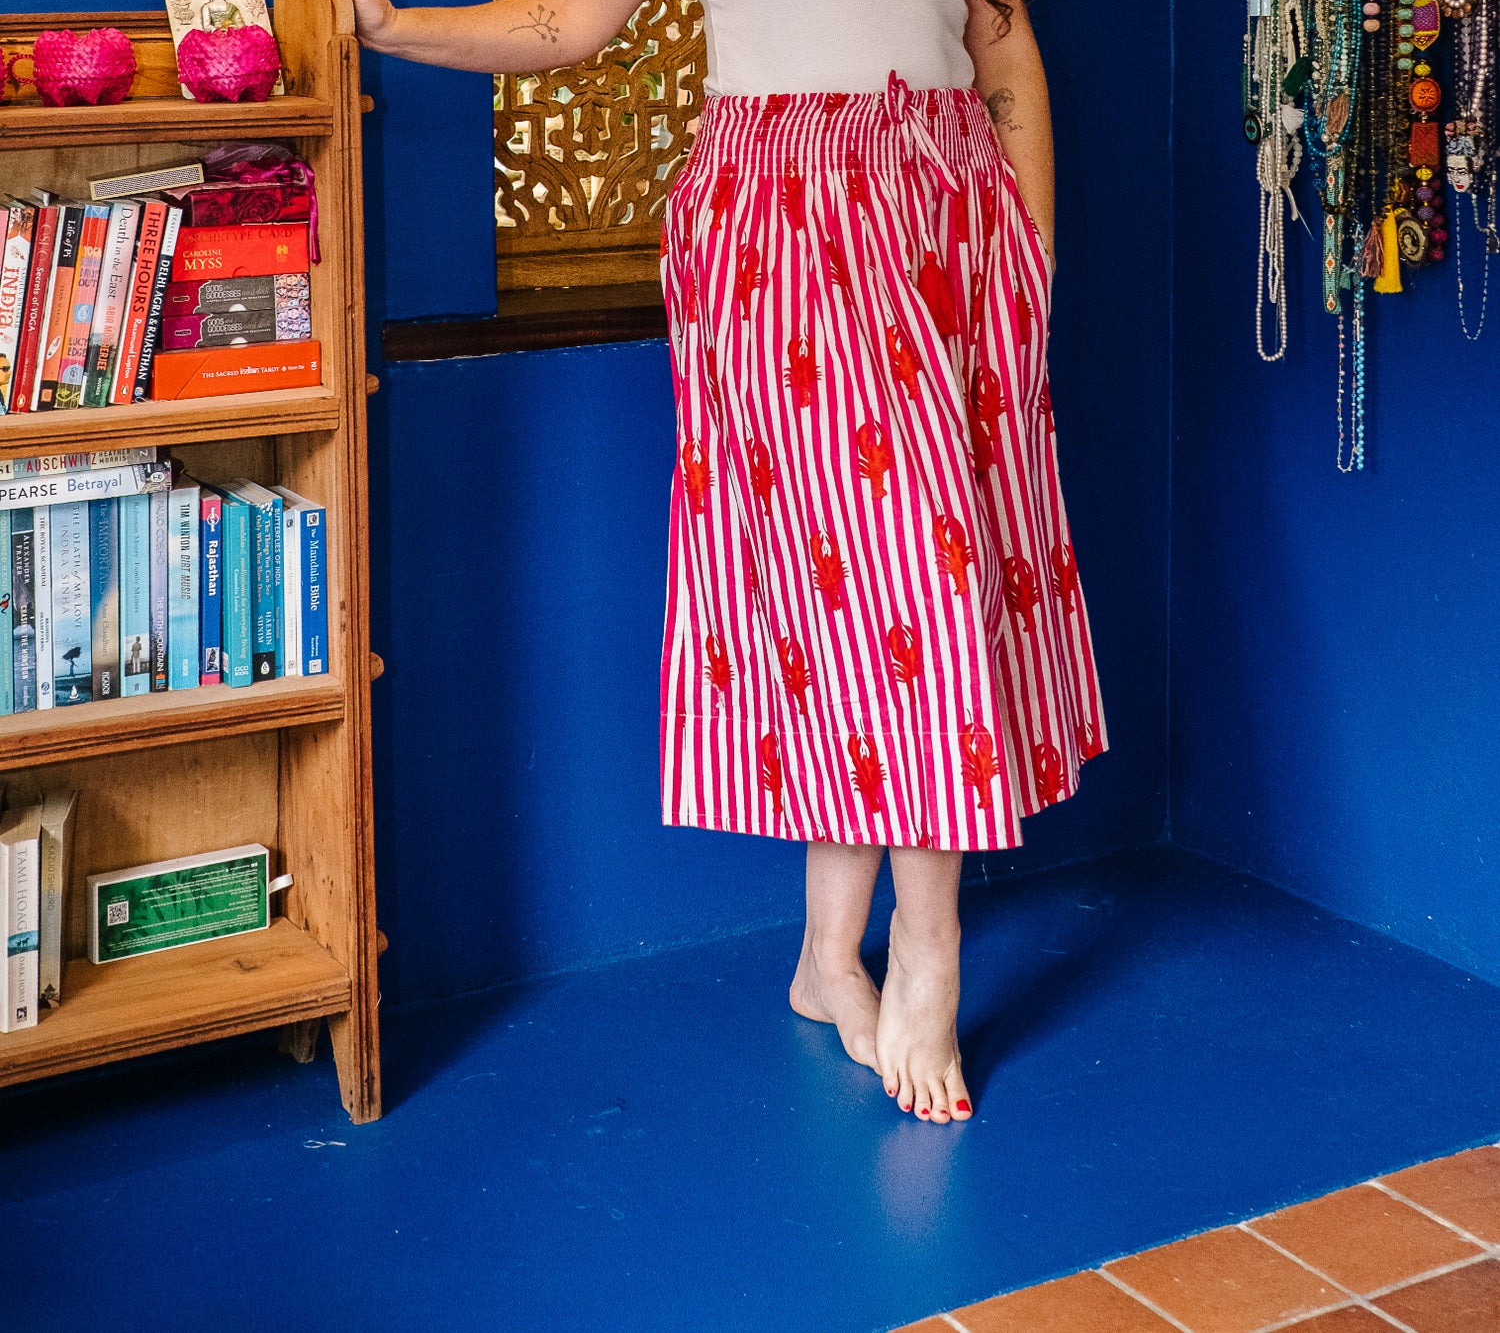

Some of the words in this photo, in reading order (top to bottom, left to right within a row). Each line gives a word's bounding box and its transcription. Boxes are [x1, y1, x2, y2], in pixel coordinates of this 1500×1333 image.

[66, 220, 76, 236] Life
[116, 207, 134, 244] Death
[144, 211, 161, 254] THREE
[63, 249, 72, 258] Pi
[64, 238, 74, 248] of
[115, 247, 122, 255] in
[183, 248, 222, 258] CAROLINE
[113, 258, 122, 271] the
[184, 257, 222, 270] MYSS
[34, 266, 44, 294] Secrets
[78, 278, 98, 287] OUT
[107, 275, 121, 299] East
[134, 260, 152, 313] HOURS
[205, 284, 223, 292] GODS
[32, 297, 40, 305] of
[150, 290, 163, 316] AGRA
[206, 290, 241, 299] GODDESSES
[28, 307, 39, 331] YOGA
[105, 305, 116, 323] ABIR
[207, 318, 224, 326] GODS
[129, 318, 142, 353] Rosamund
[208, 324, 242, 332] GODDESSES
[67, 347, 86, 356] EDGE
[69, 337, 87, 346] LUCY
[138, 326, 156, 379] RAJASTHAN
[123, 354, 136, 378] Lupton
[14, 463, 25, 472] OF
[26, 452, 97, 473] AUSCHWITZ
[99, 448, 131, 458] HEATHER
[99, 455, 127, 464] MORRIS
[0, 483, 57, 501] PEARSE
[67, 473, 122, 493] Betrayal
[72, 506, 80, 526] THE
[156, 500, 164, 525] PAULO
[180, 504, 190, 518] TIM
[255, 515, 263, 531] Only
[61, 524, 70, 567] INDRA
[156, 528, 164, 565] COELHO
[180, 520, 190, 551] WINTON
[263, 533, 272, 555] Things
[22, 535, 31, 584] ALEXANDER
[72, 533, 81, 568] DEATH
[274, 554, 281, 565] OF
[309, 540, 319, 583] Mandala
[72, 570, 81, 578] of
[180, 554, 190, 572] DIRT
[208, 540, 219, 596] Rajasthan
[61, 575, 70, 615] SINHA
[73, 583, 81, 599] MR
[180, 574, 191, 600] MUSIC
[264, 584, 272, 595] See
[310, 585, 320, 611] Bible
[74, 604, 82, 628] LOVE
[156, 610, 164, 630] FIFTH
[156, 631, 164, 672] MOUNTAIN
[21, 648, 29, 680] MONSOON
[16, 848, 27, 883] TAMI
[47, 845, 56, 872] KAZUO
[47, 873, 55, 911] ISHIGURO
[17, 889, 27, 931] HOAG
[18, 956, 26, 978] DARK
[18, 979, 26, 1004] HORSE
